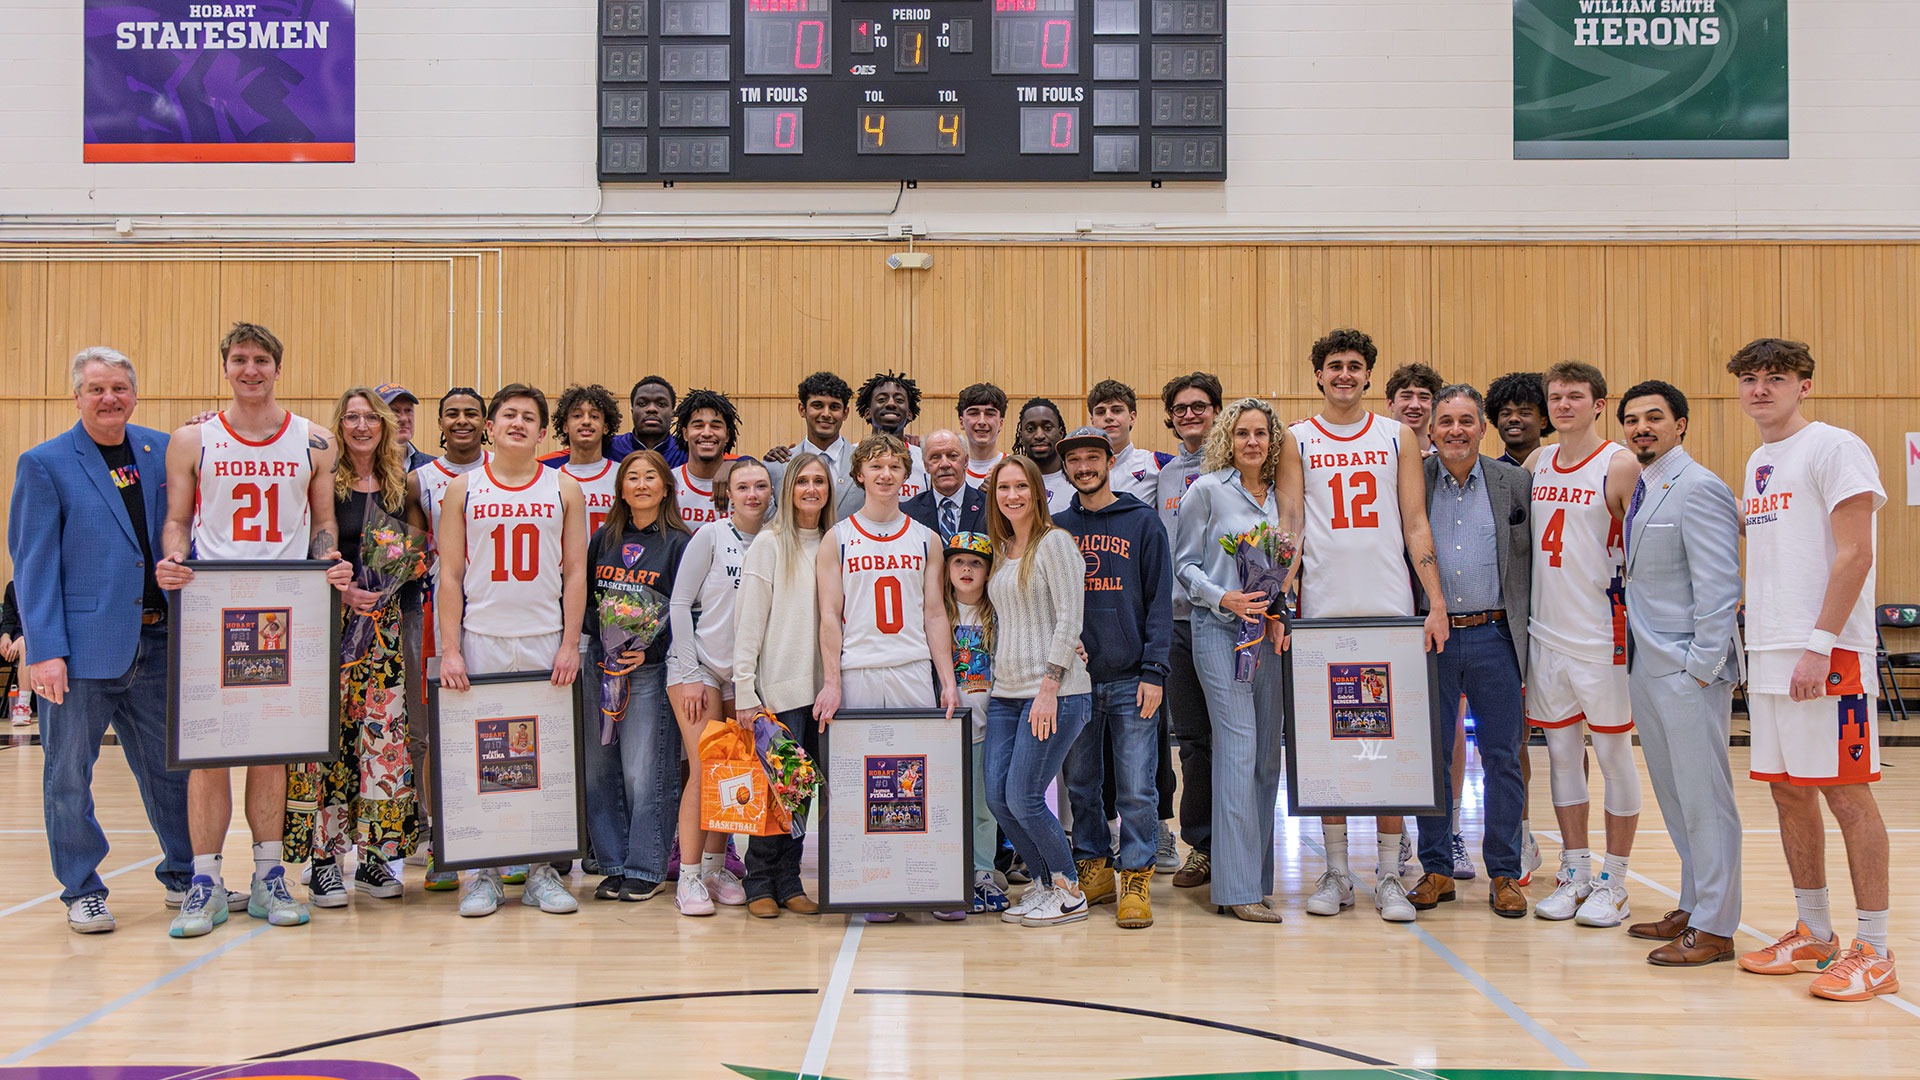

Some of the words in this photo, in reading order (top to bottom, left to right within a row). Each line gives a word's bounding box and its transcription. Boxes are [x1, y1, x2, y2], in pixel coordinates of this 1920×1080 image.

[189, 4, 256, 18] HOBART
[892, 9, 931, 20] PERIOD
[1579, 0, 1656, 13] WILLIAM
[1660, 0, 1715, 13] SMITH
[116, 21, 330, 50] STATESMEN
[874, 23, 882, 35] P
[942, 23, 950, 35] P
[1573, 17, 1721, 46] HERONS
[794, 20, 824, 69] 0
[874, 36, 888, 48] TO
[914, 33, 922, 65] 1
[936, 36, 950, 48] TO
[1041, 20, 1071, 69] 0
[740, 87, 761, 102] TM
[766, 87, 808, 102] FOULS
[864, 90, 885, 102] TOL
[938, 90, 959, 102] TOL
[1016, 87, 1038, 102] TM
[1042, 87, 1084, 102] FOULS
[775, 112, 797, 148] 0
[864, 114, 886, 147] 4
[938, 114, 960, 147] 4
[1051, 112, 1073, 148] 0
[214, 460, 300, 478] HOBART
[1309, 451, 1389, 470] HOBART
[1327, 471, 1380, 530] 12
[1532, 486, 1597, 505] HOBART
[231, 482, 283, 543] 21
[473, 503, 556, 519] HOBART
[1541, 508, 1566, 568] 4
[490, 523, 541, 583] 10
[847, 554, 923, 573] HOBART
[596, 565, 661, 586] HOBART
[597, 580, 644, 592] BASKETBALL
[874, 575, 904, 635] 0
[708, 819, 758, 833] BASKETBALL
